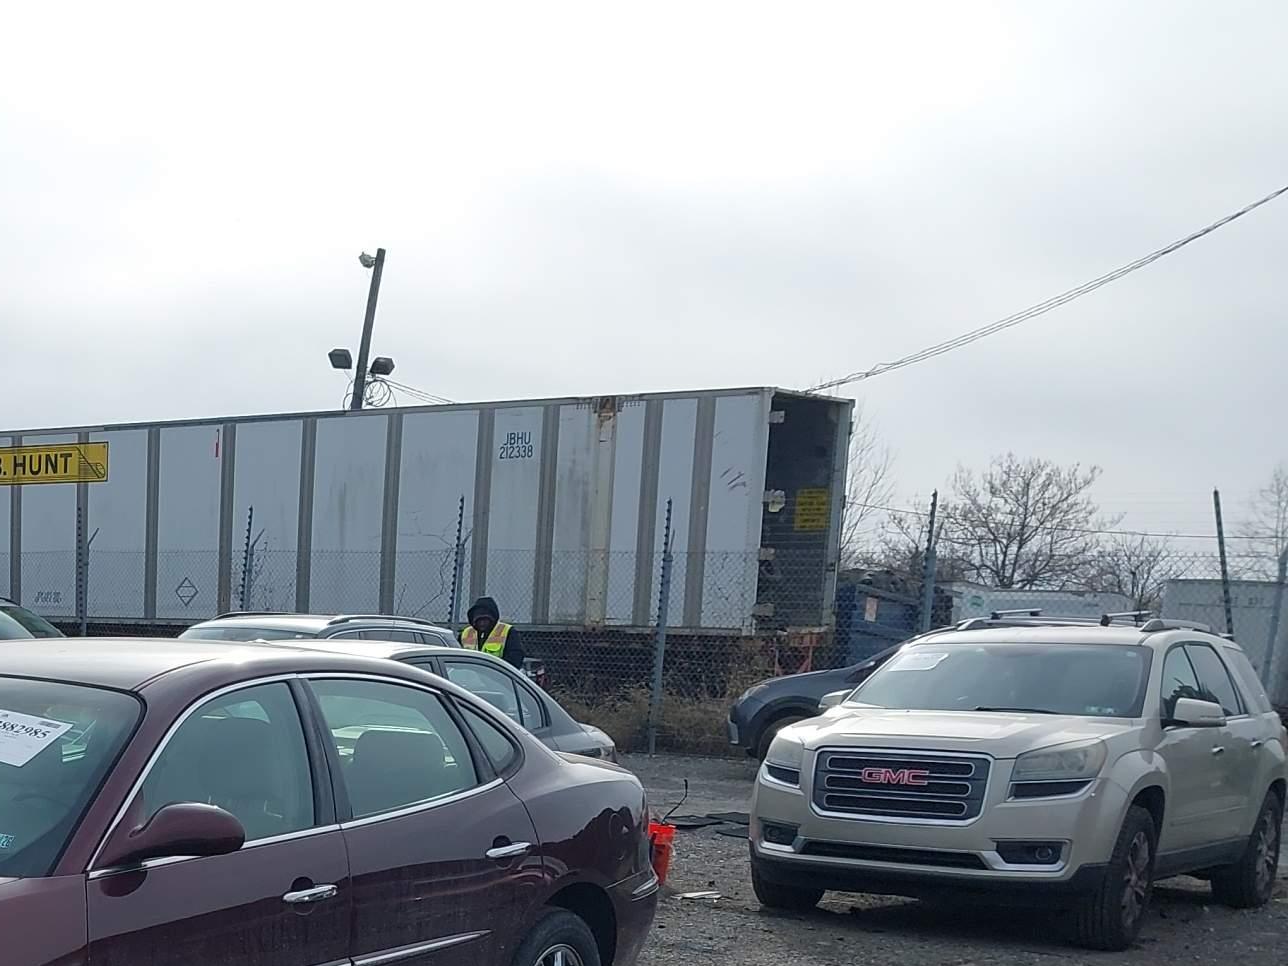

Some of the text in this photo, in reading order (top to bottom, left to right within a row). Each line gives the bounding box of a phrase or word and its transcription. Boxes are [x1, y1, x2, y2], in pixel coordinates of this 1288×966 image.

[503, 431, 531, 445] JBHU
[499, 444, 533, 459] 212338
[13, 452, 73, 476] HUNT
[862, 767, 930, 786] GMC
